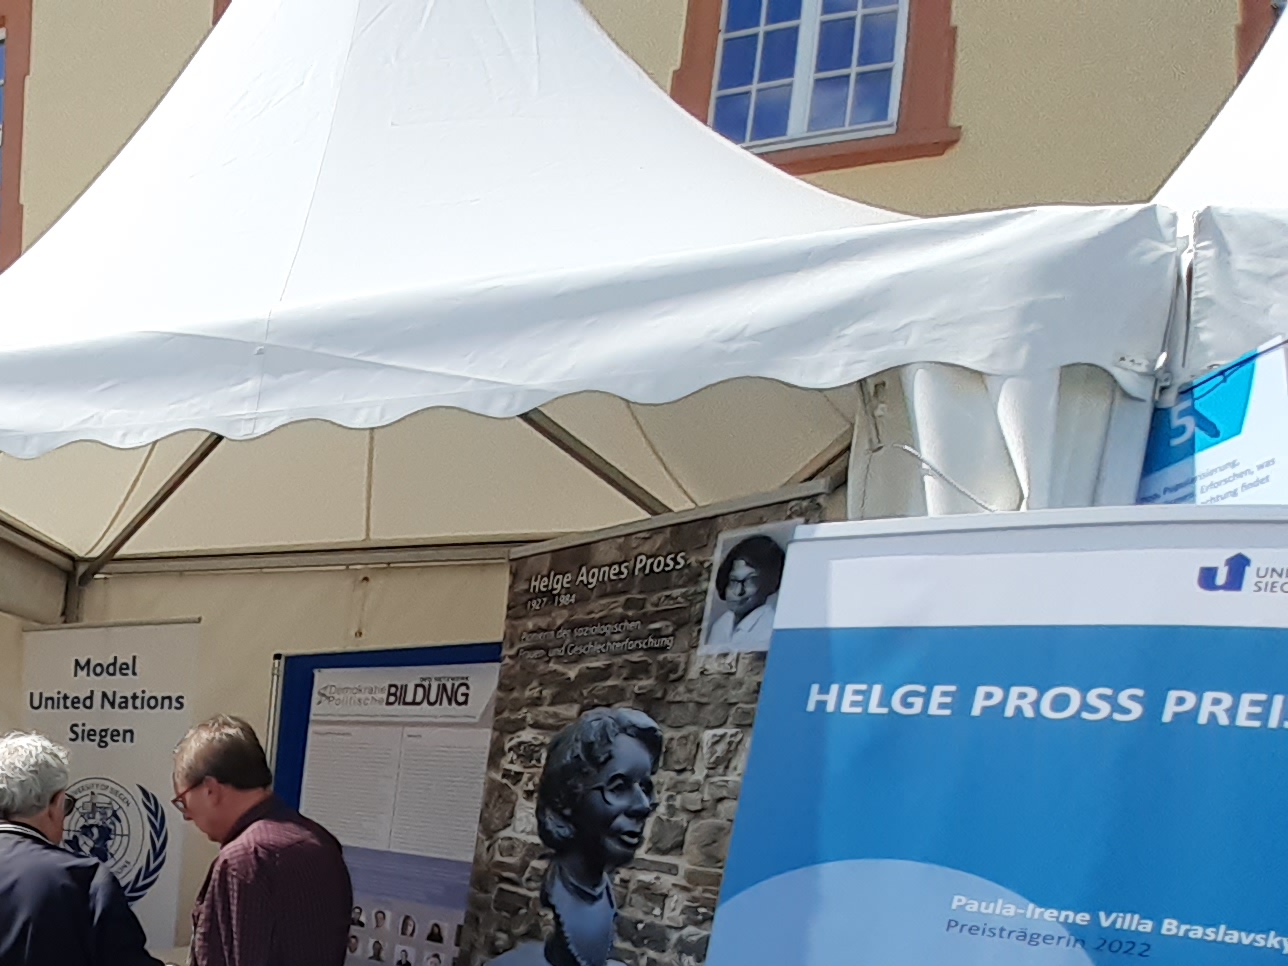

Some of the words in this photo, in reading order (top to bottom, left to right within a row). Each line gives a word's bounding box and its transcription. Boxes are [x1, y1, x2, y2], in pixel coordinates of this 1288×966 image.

[530, 571, 572, 594] Helge
[575, 562, 629, 589] Agnes
[634, 551, 686, 576] Pross
[73, 655, 138, 677] Model
[29, 689, 94, 710] United
[100, 689, 185, 711] Nations
[385, 682, 471, 706] BILDUNG
[806, 682, 958, 717] HELGE
[969, 685, 1145, 722] PROSS
[1160, 689, 1288, 730] PREI
[68, 722, 135, 748] Siegen
[945, 918, 1086, 948] Preisträgerin
[1094, 937, 1152, 957] 2022
[951, 894, 1092, 926] Paula-Irene
[1099, 911, 1154, 932] Villa
[1160, 917, 1288, 955] Braslavsky
